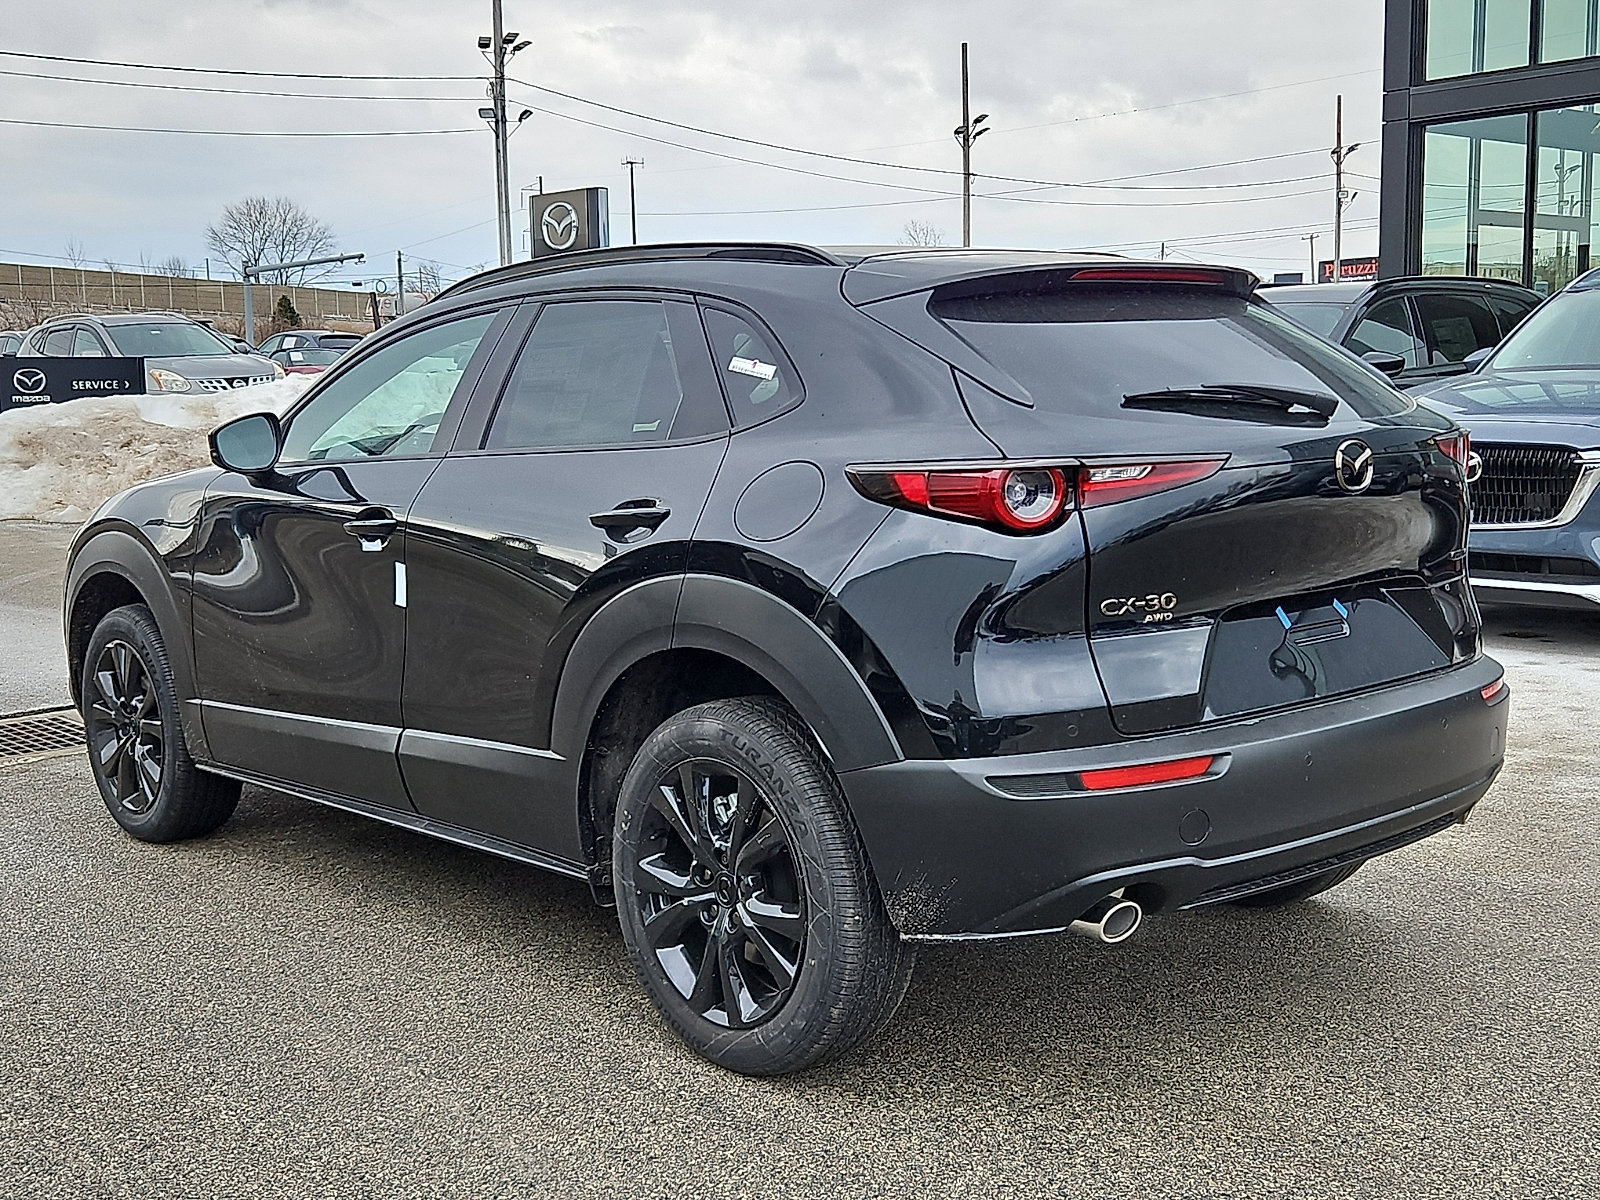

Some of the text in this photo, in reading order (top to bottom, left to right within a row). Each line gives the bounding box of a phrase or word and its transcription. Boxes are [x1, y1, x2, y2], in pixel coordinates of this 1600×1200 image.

[1324, 259, 1378, 277] Pruzzi
[71, 380, 120, 390] SERVICE
[11, 395, 51, 403] mazda
[1100, 592, 1178, 616] CX-30
[1142, 612, 1174, 624] AWD
